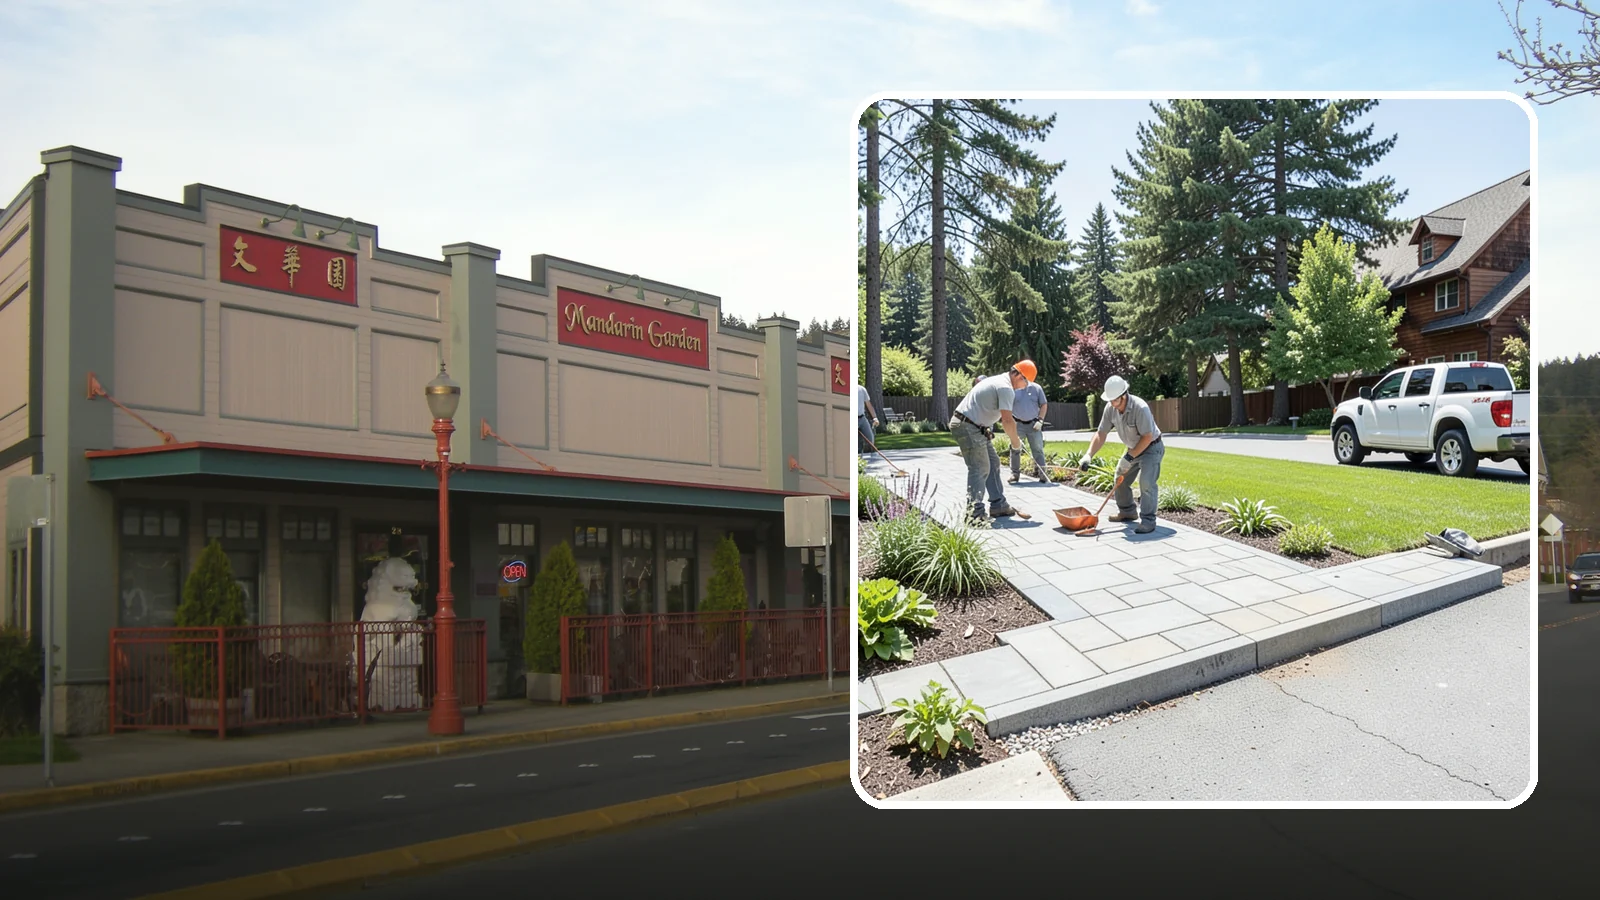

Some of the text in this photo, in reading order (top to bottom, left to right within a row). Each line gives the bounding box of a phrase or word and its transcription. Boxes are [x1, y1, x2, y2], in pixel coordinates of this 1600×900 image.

[564, 302, 701, 352] Mandarin Garden
[503, 565, 527, 578] OPEN
